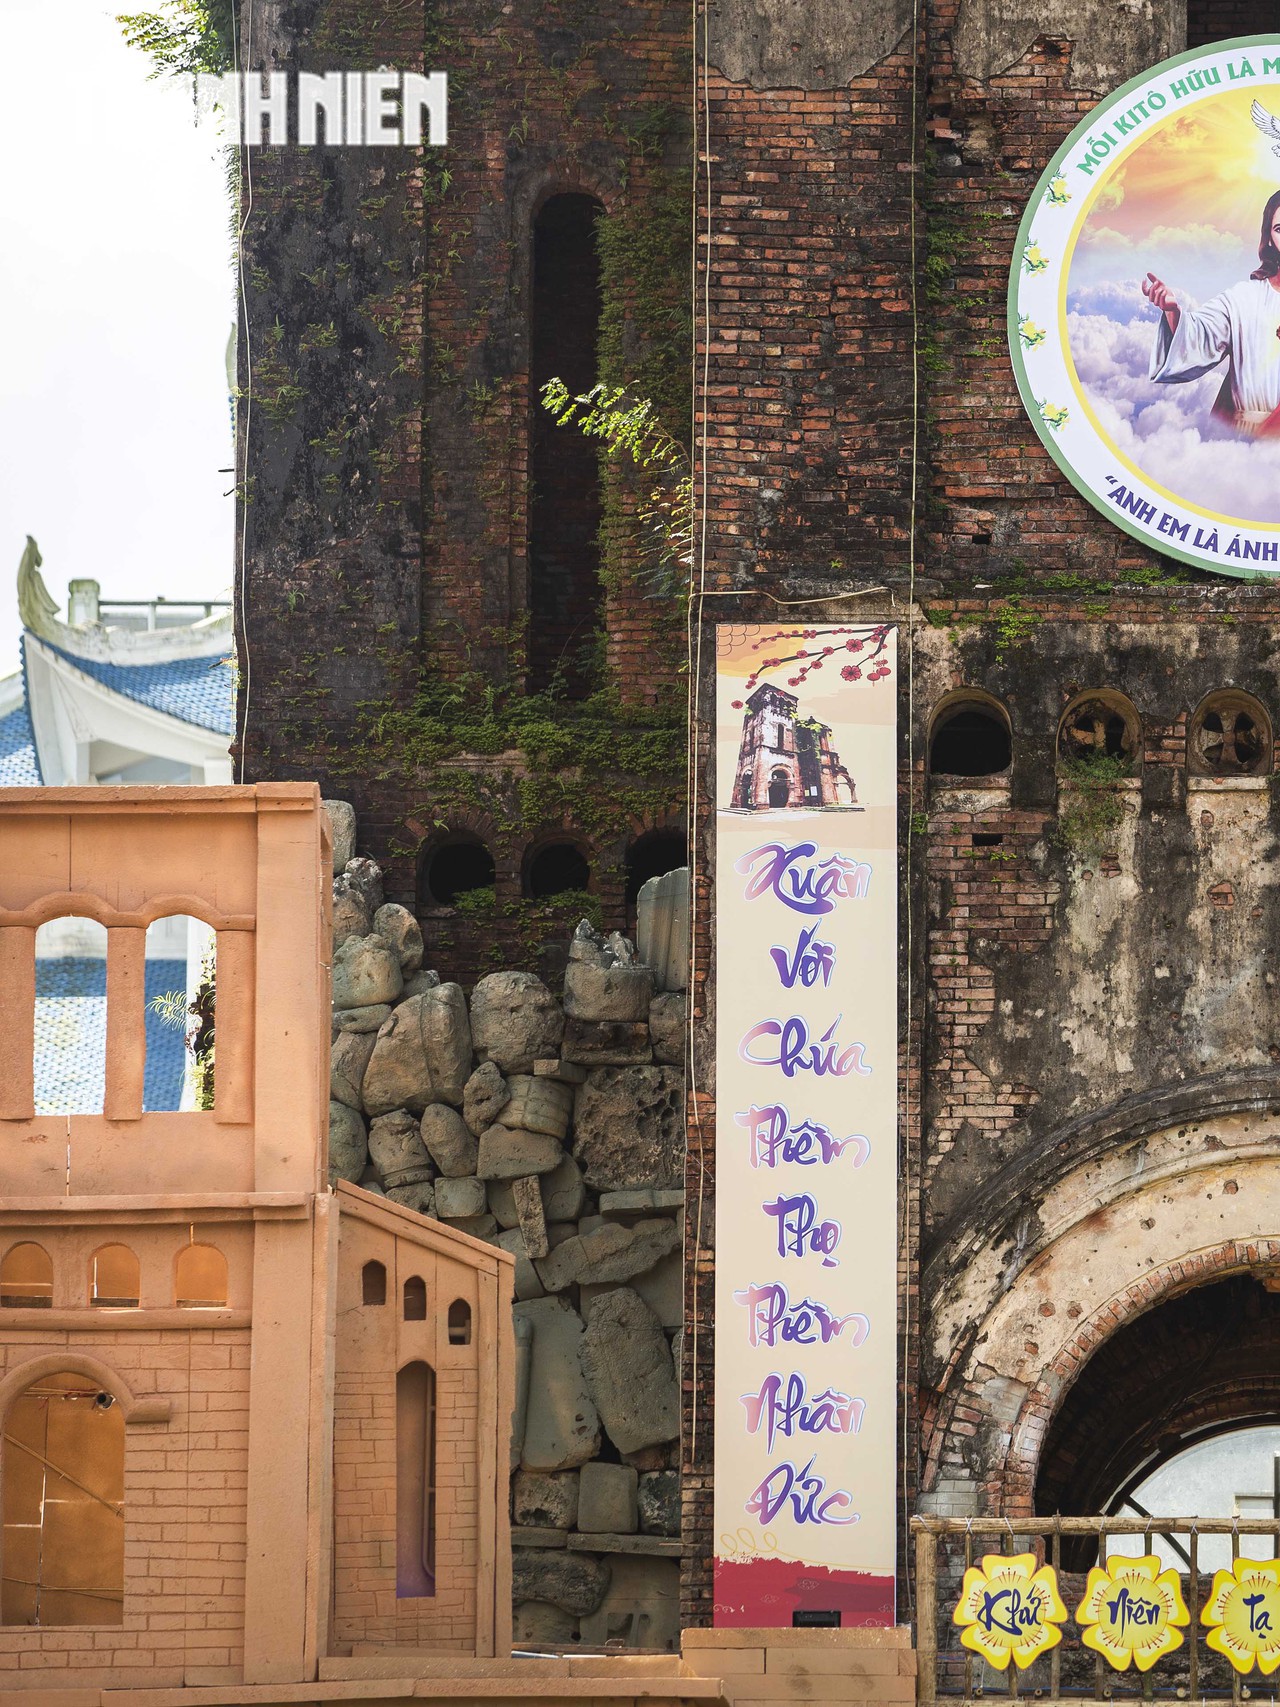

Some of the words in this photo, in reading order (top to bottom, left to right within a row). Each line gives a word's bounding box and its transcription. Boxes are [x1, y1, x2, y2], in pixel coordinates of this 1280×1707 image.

[1076, 131, 1119, 176] MỖI
[1113, 90, 1167, 136] KITÔ
[1169, 66, 1222, 99] HỮU
[1226, 57, 1257, 80] LÀ
[1156, 512, 1191, 542] EM
[1192, 528, 1219, 553] LÀ
[1224, 533, 1278, 561] ÁNH
[734, 840, 873, 915] Xuân
[769, 917, 837, 989] Với
[737, 1013, 873, 1077] Chúa
[734, 1102, 871, 1170] Thêm
[762, 1191, 842, 1269] Thọ
[732, 1281, 870, 1349] Thêm
[738, 1371, 868, 1456] Nhân
[744, 1453, 861, 1527] Đức
[1106, 1587, 1161, 1638] Niên
[1242, 1593, 1274, 1639] Tạ
